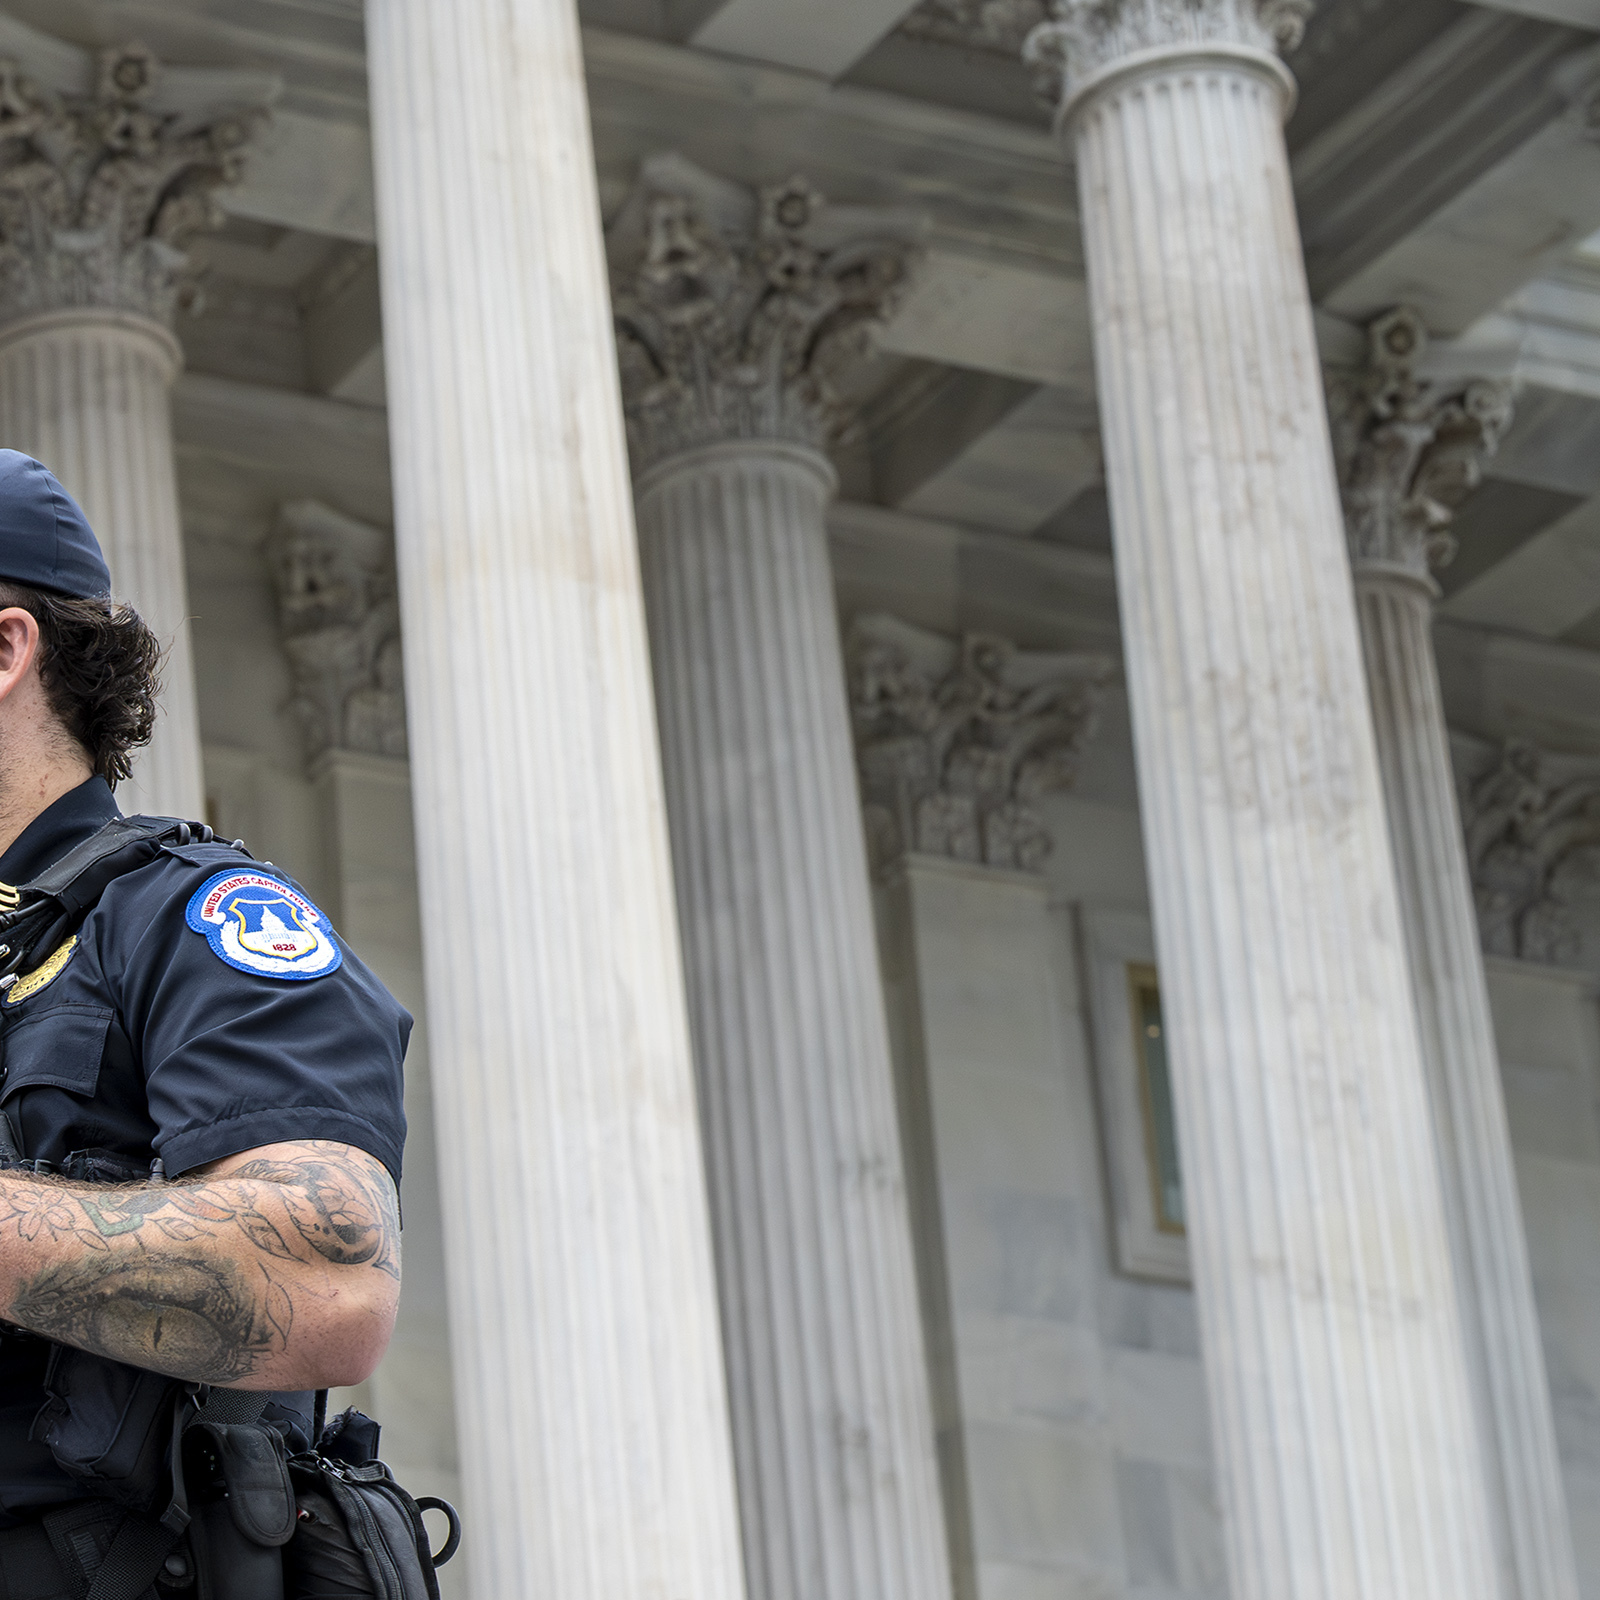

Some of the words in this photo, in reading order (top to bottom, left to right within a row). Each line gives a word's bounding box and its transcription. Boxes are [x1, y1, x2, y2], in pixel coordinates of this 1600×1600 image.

[203, 892, 222, 918] UNITED
[217, 877, 250, 894] STATES
[250, 877, 288, 896] CAPITOL
[272, 943, 297, 952] 1828
